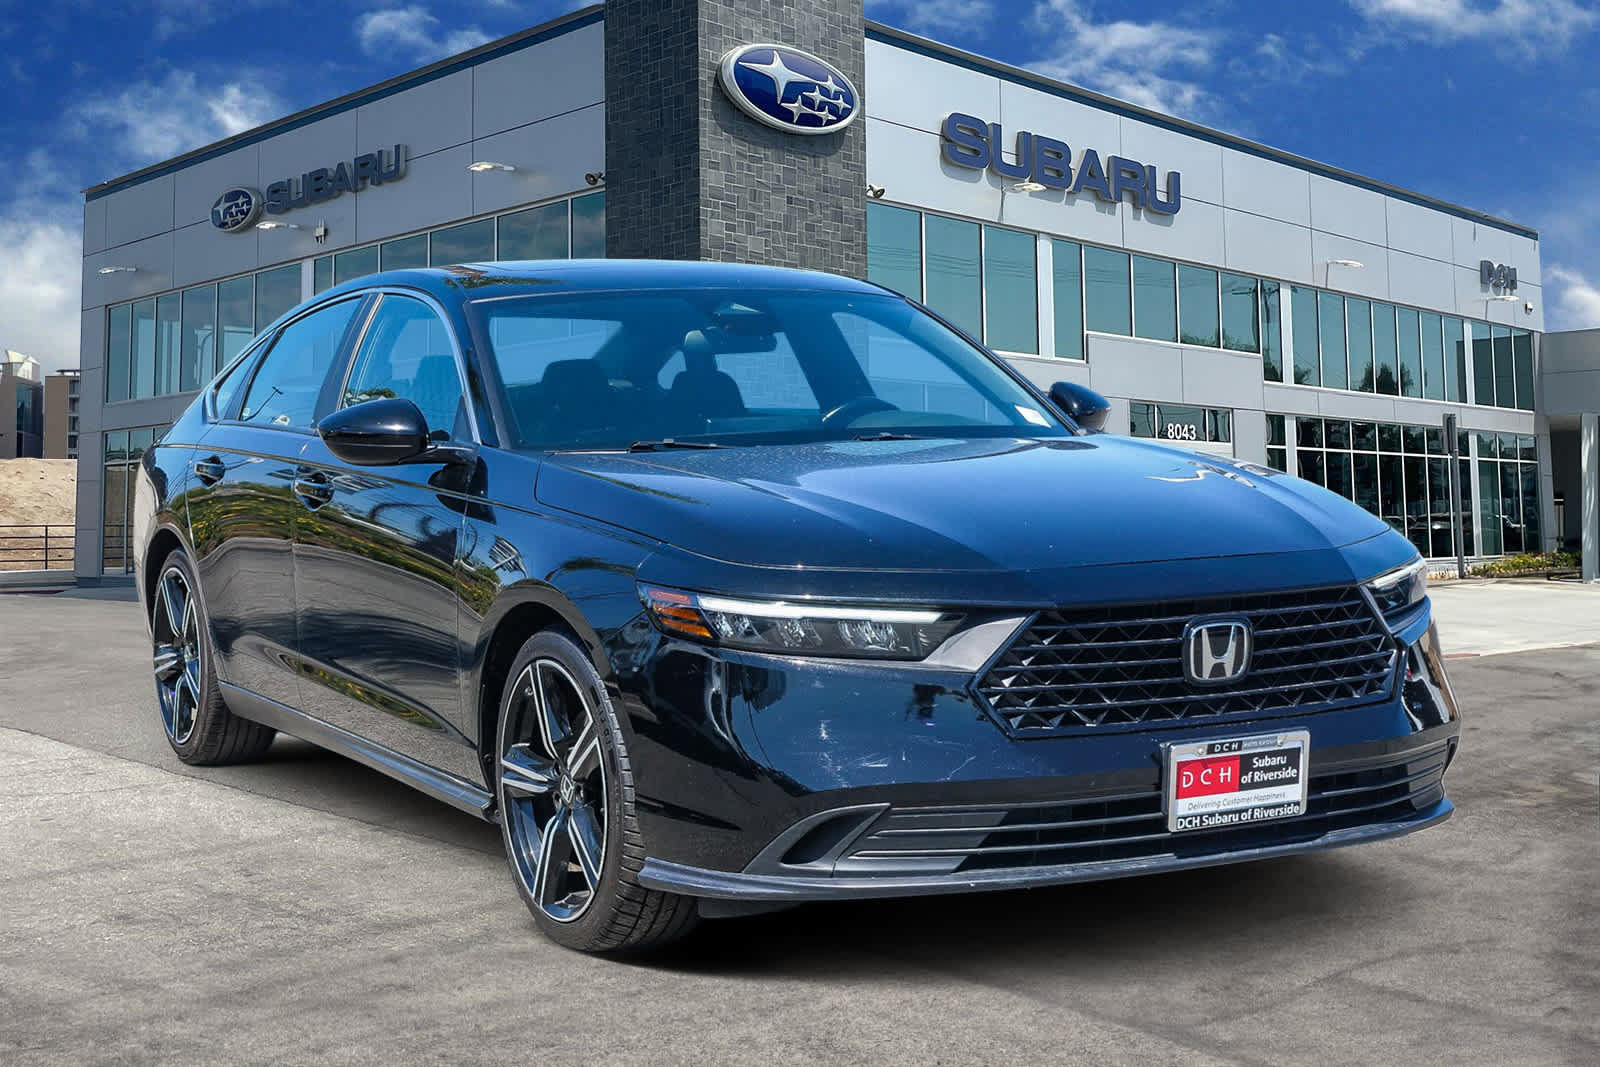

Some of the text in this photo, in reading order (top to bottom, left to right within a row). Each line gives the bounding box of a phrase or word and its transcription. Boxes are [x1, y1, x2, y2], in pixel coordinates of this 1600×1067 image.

[941, 112, 1181, 216] SUBARU
[265, 143, 408, 215] SUBARU
[1167, 423, 1196, 440] 8043
[1252, 755, 1287, 768] Subaru
[1240, 766, 1298, 784] of Riverside
[1177, 803, 1300, 829] DCH Subaru of Riverside
